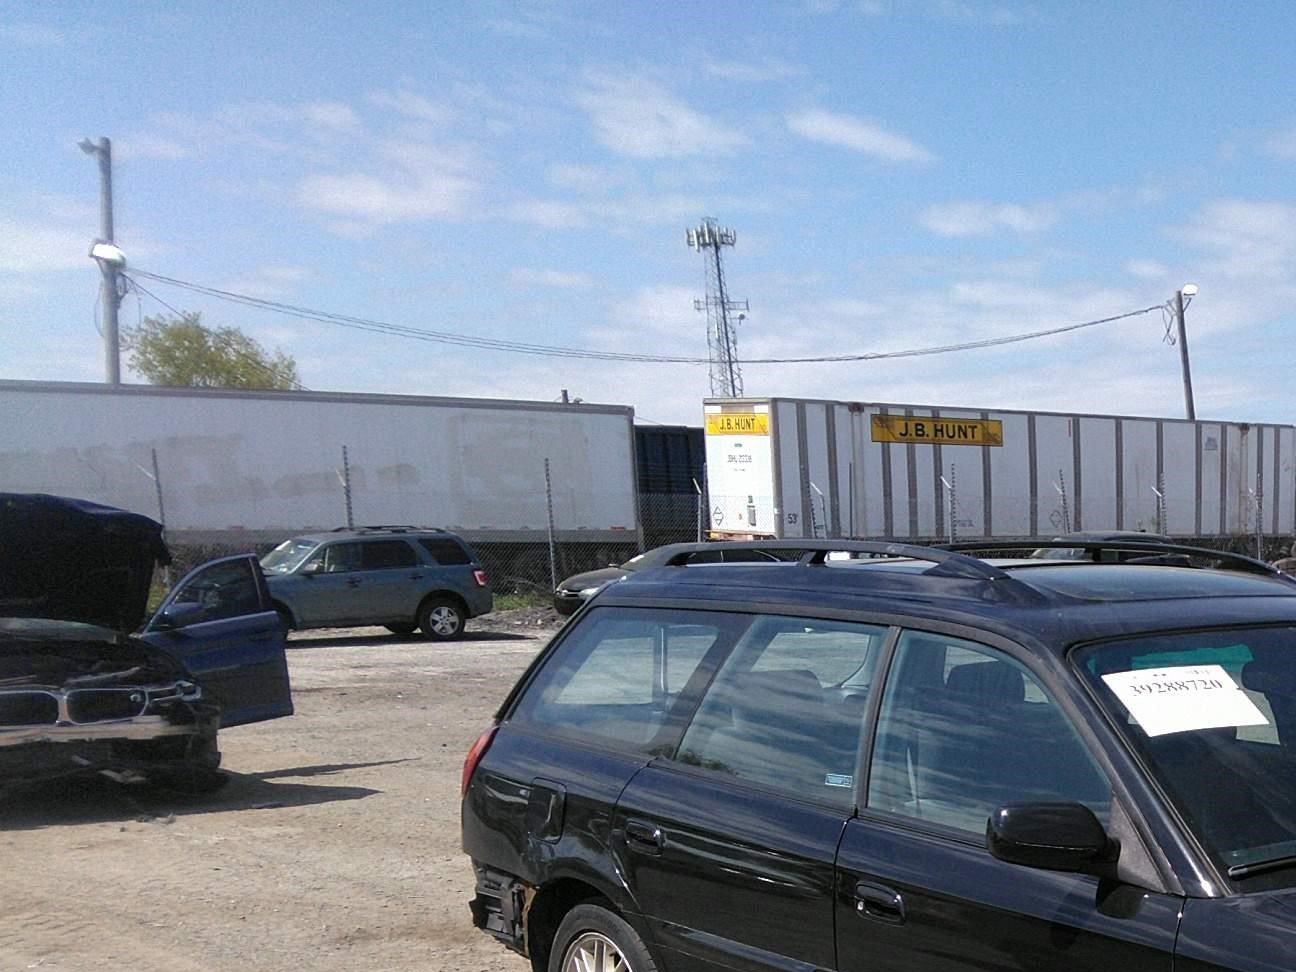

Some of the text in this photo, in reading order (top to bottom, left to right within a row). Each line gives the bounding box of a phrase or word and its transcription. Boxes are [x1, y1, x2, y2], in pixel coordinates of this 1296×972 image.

[720, 417, 756, 430] J.B. HUNT
[899, 422, 977, 440] J.B. HUNT
[1128, 679, 1224, 697] 39288720
